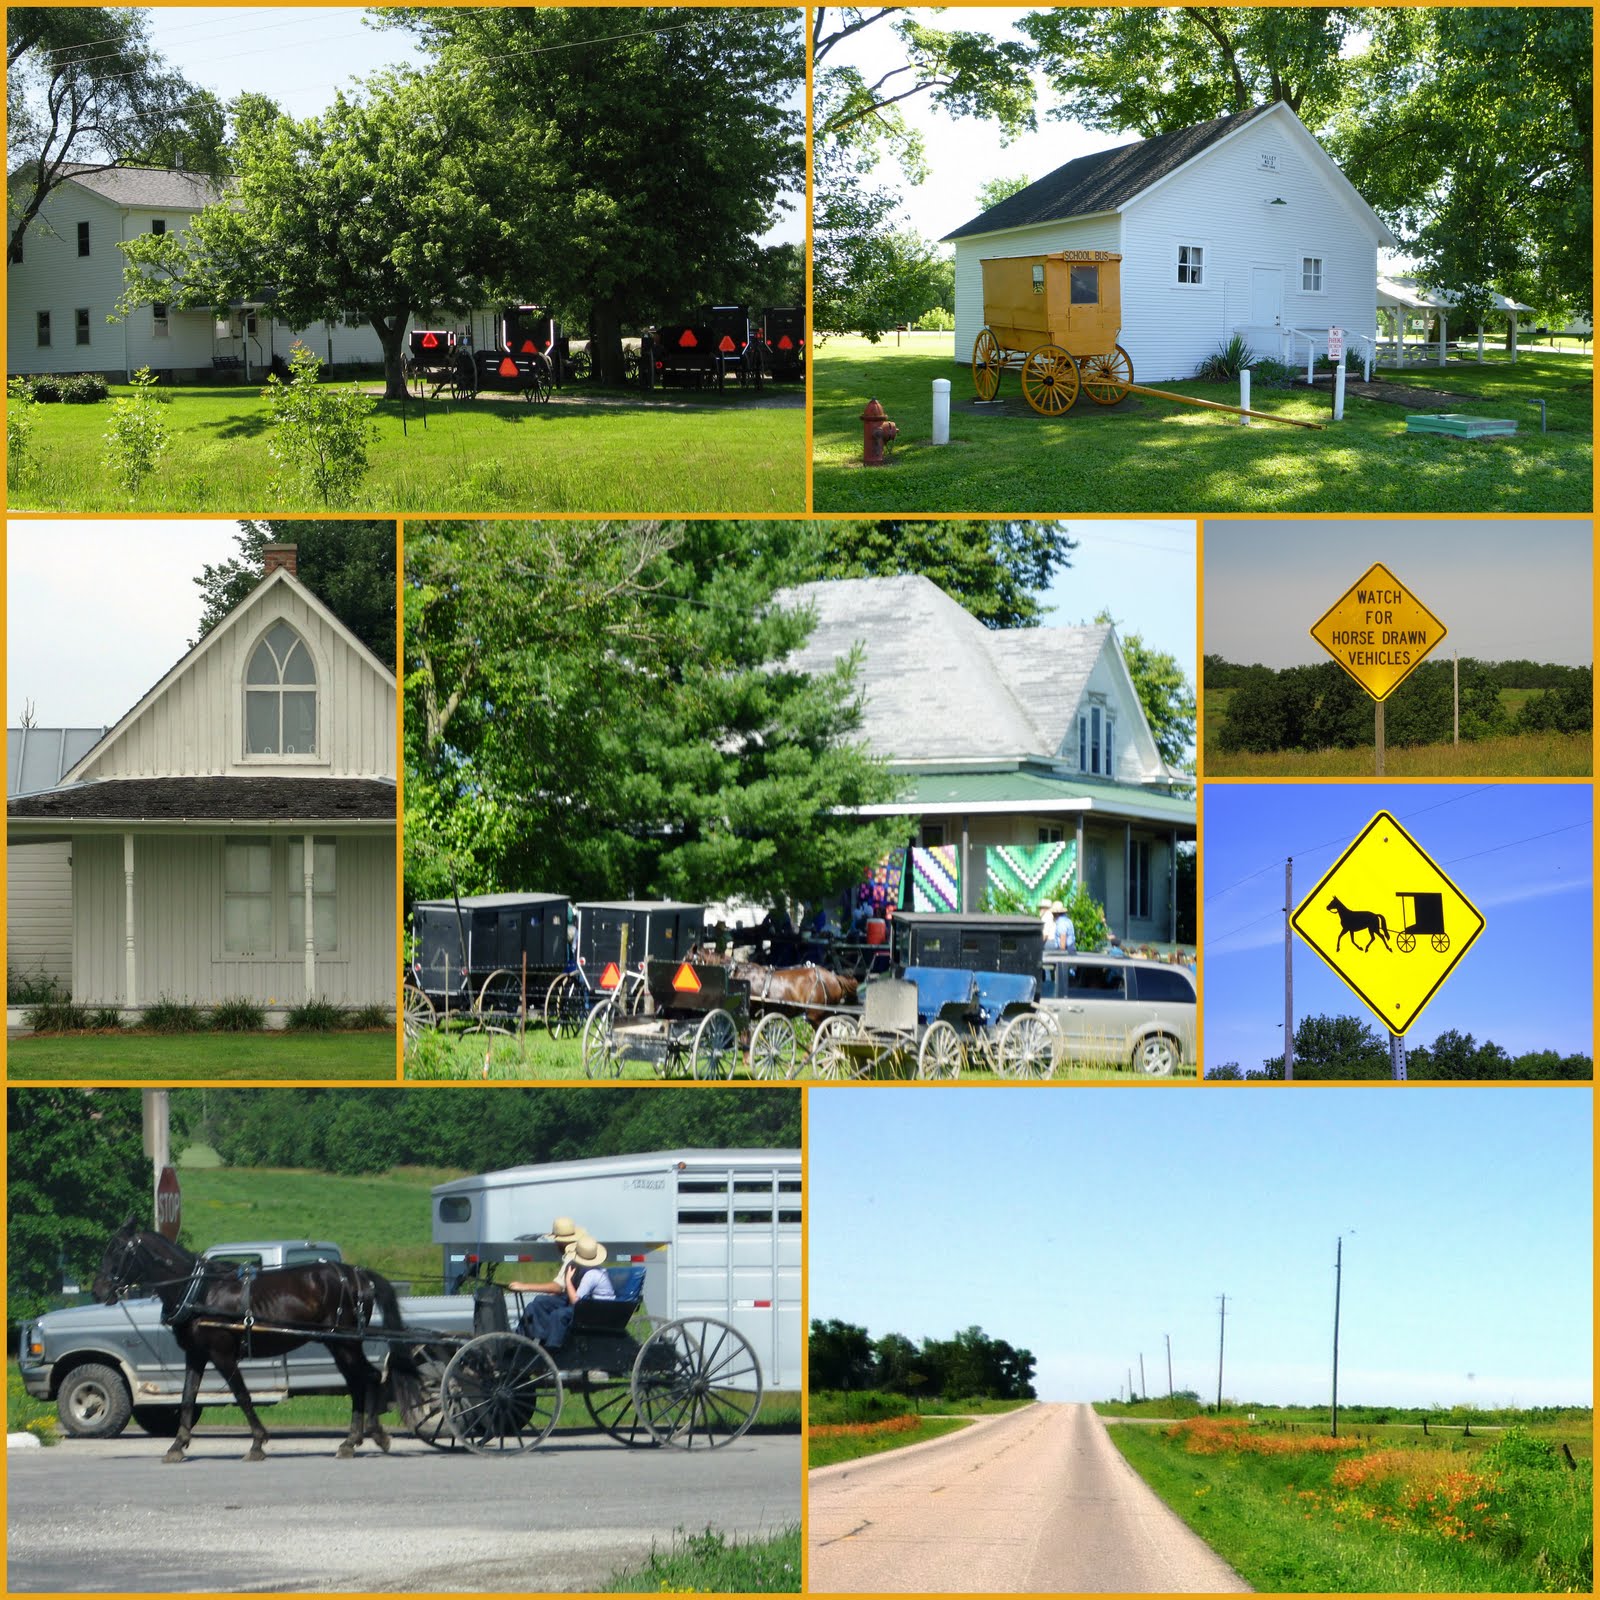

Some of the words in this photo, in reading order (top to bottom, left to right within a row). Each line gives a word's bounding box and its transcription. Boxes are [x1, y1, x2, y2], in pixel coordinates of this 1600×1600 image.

[1064, 250, 1091, 261] SCHOOL
[1094, 250, 1109, 261] BUS
[1357, 590, 1402, 604] WATCH
[1365, 610, 1393, 625] FOR
[1332, 630, 1375, 645] HORSE
[1382, 630, 1427, 645] DRAWN
[1348, 651, 1411, 666] VEHICLES
[158, 1192, 180, 1224] STOP
